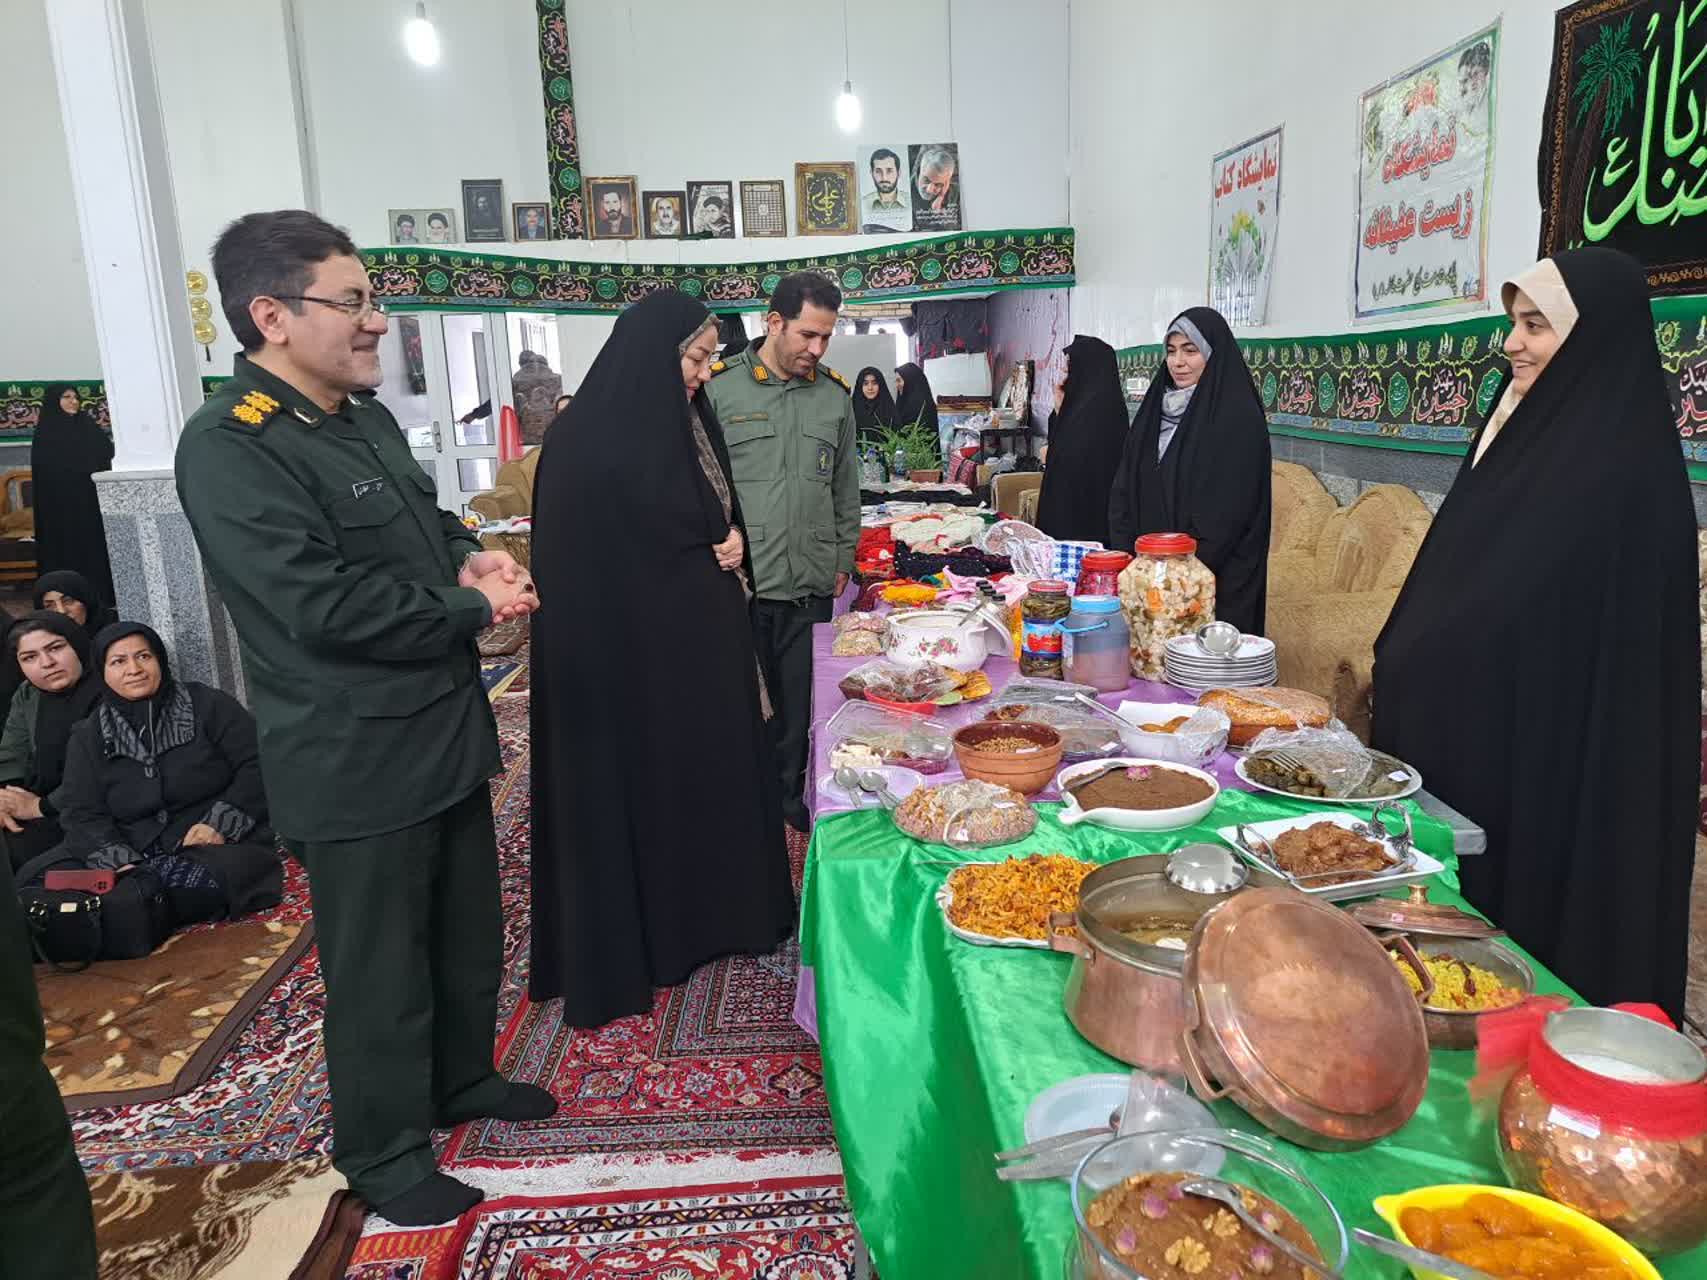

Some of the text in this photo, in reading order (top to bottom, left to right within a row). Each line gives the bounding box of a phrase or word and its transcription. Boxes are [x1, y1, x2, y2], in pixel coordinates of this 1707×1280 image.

[1214, 142, 1278, 207] نمایشگاه کتاب
[1381, 111, 1457, 183] نمایشگاه
[1363, 186, 1473, 254] زیست عفیفانه
